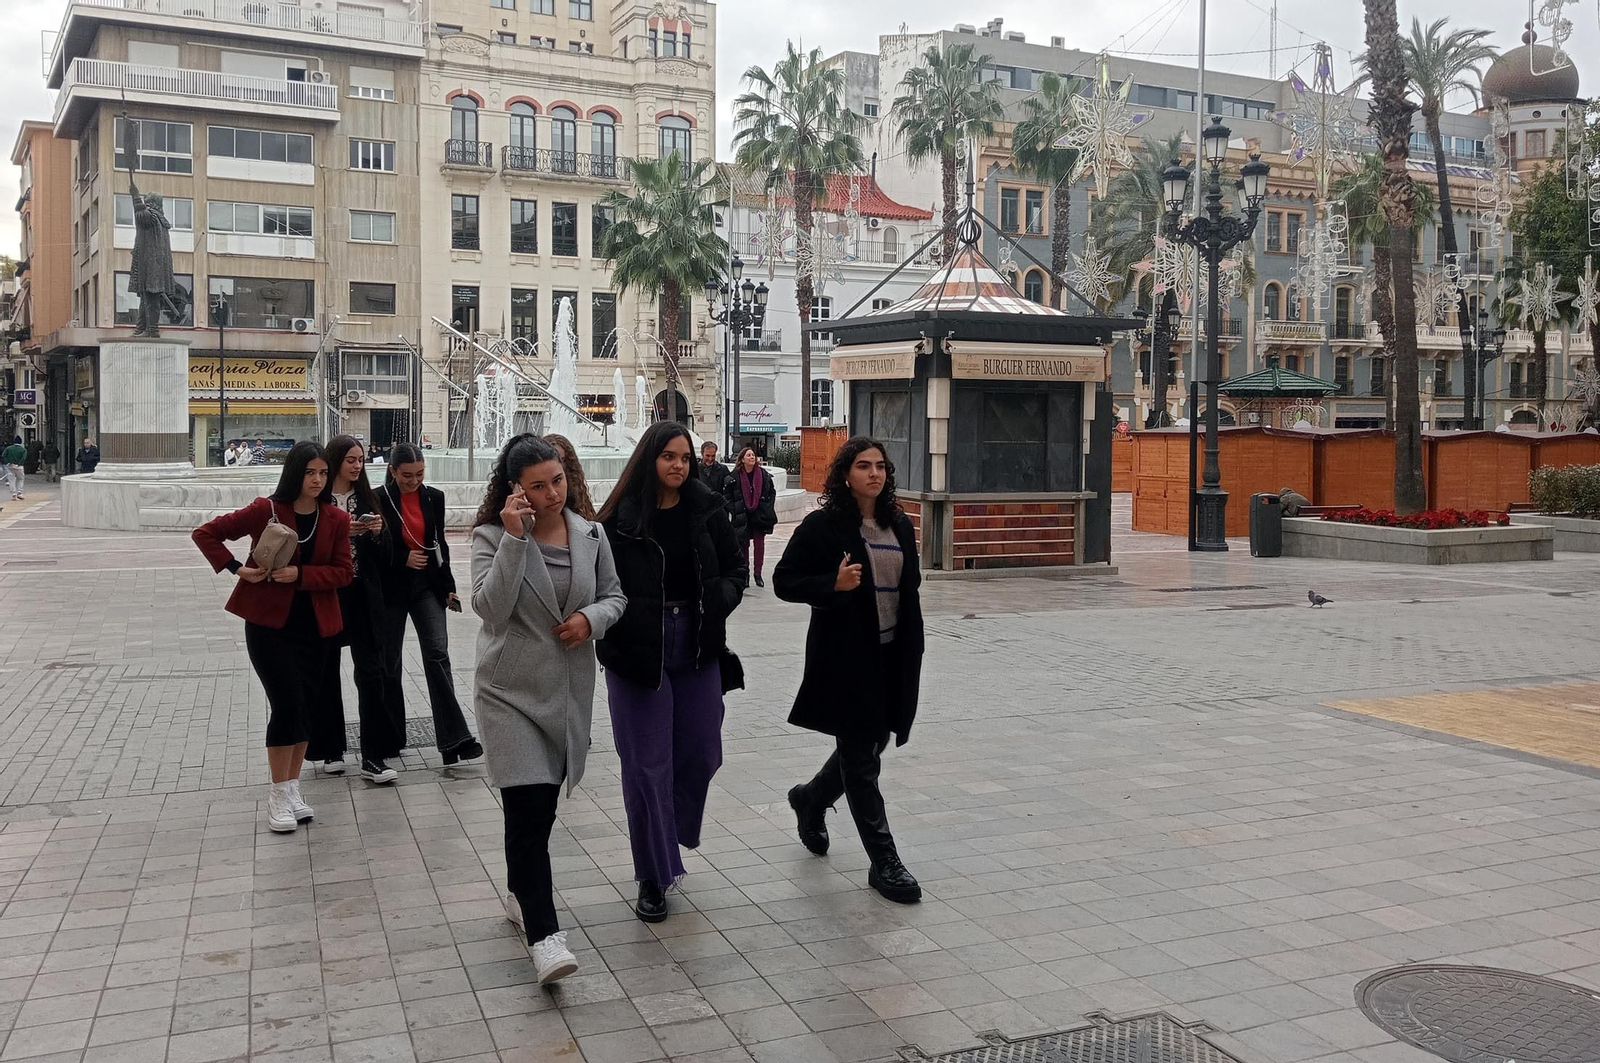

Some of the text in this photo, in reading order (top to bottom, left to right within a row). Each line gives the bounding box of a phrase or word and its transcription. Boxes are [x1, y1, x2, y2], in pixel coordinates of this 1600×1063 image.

[189, 360, 306, 380] cajeria Plaza
[983, 358, 1023, 375] BURGUER
[1026, 360, 1072, 376] FERNANDO
[223, 380, 256, 389] MEDIAS
[264, 381, 301, 389] LABORES
